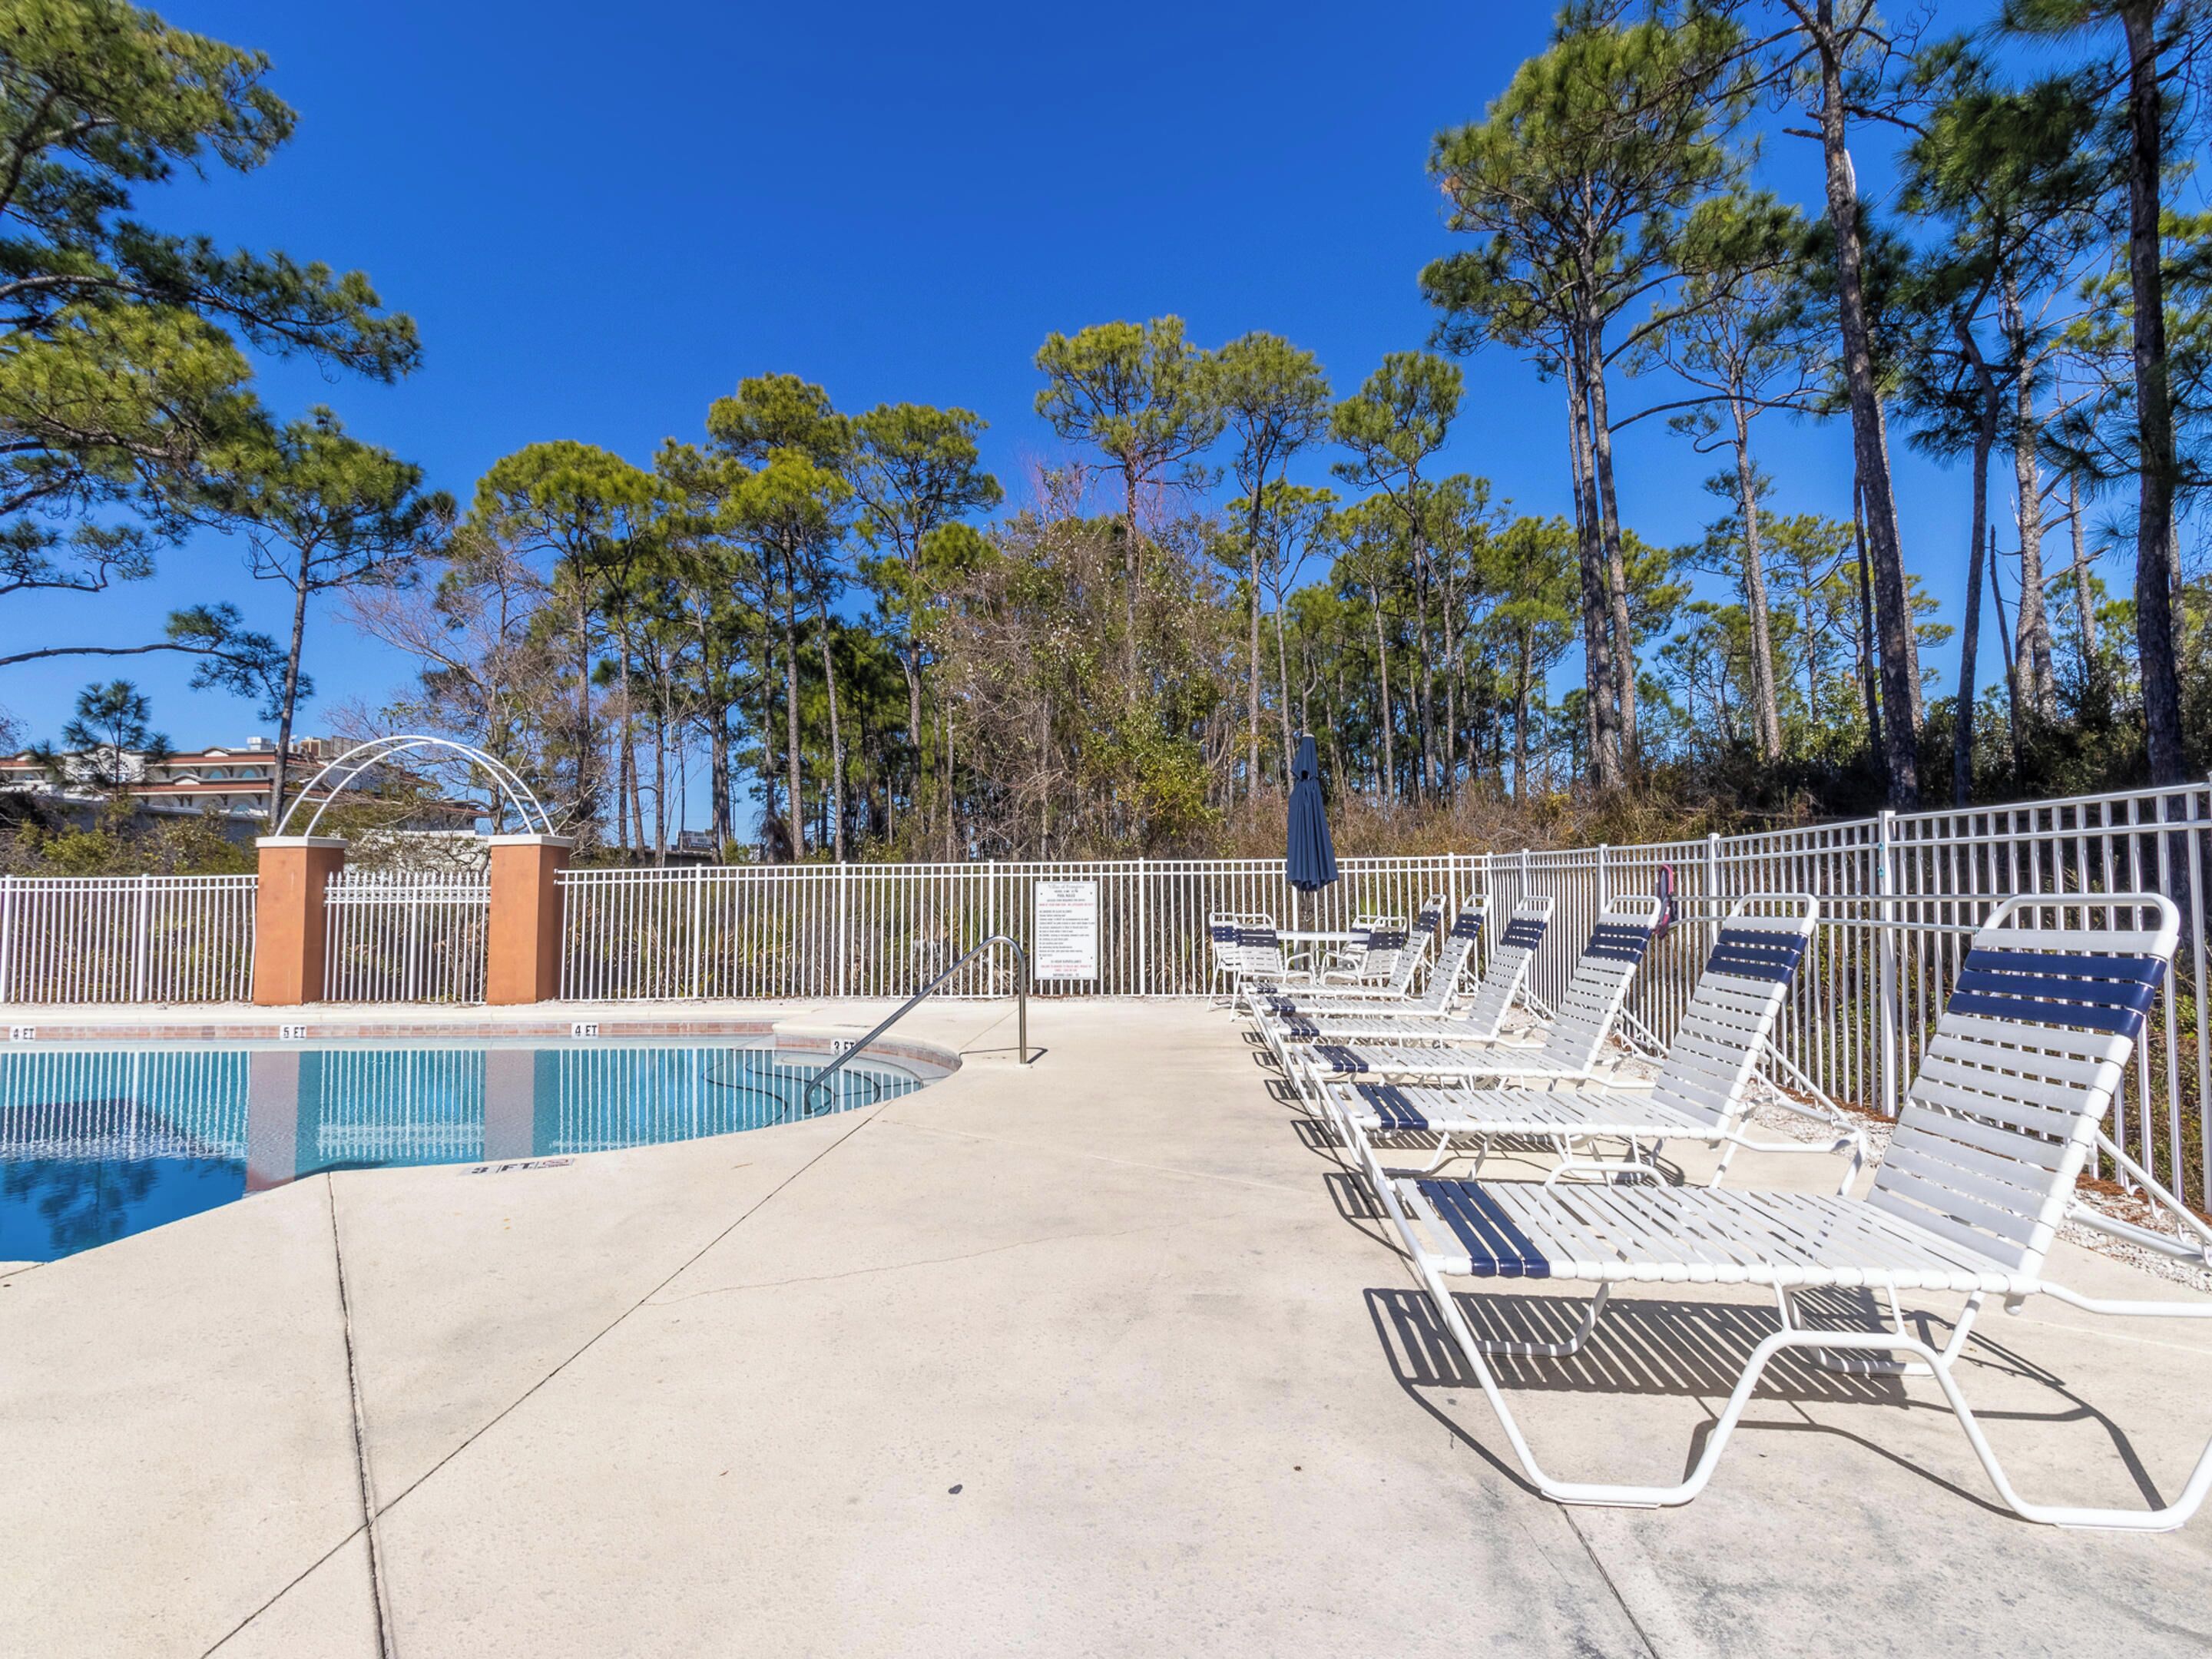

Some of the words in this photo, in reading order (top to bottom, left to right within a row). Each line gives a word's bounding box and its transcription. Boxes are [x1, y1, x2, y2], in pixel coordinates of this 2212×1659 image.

[13, 1028, 19, 1040] 4
[283, 1026, 290, 1038] 5
[575, 1025, 581, 1036] 4
[585, 1025, 598, 1036] FT
[500, 1161, 535, 1172] FT
